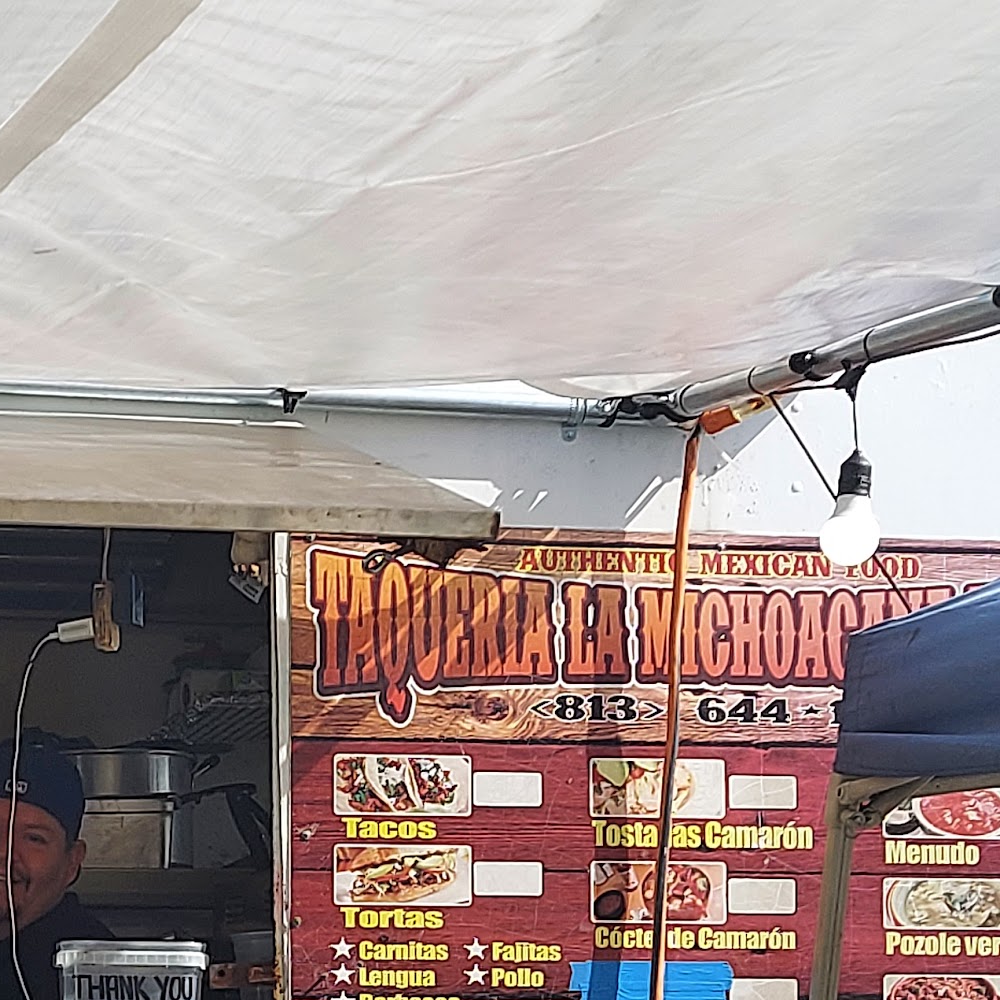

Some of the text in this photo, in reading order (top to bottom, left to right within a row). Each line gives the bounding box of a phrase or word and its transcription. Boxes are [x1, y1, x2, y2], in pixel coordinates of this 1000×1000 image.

[701, 552, 831, 577] MEXICAN
[314, 551, 956, 716] TAQUERIA LA MICHOAC
[700, 698, 789, 722] 644
[342, 817, 437, 839] Tacos
[592, 820, 814, 849] Tostaas Camarón
[885, 840, 980, 865] Menudo
[340, 907, 444, 929] Tortas
[595, 926, 797, 950] Cócte de Camarón
[885, 931, 961, 956] Pozole
[359, 941, 449, 961] Carnitas
[492, 942, 562, 963] Fajitas
[72, 974, 193, 1000] THANK YOU
[359, 967, 436, 988] Lengua
[492, 968, 545, 988] Pollo
